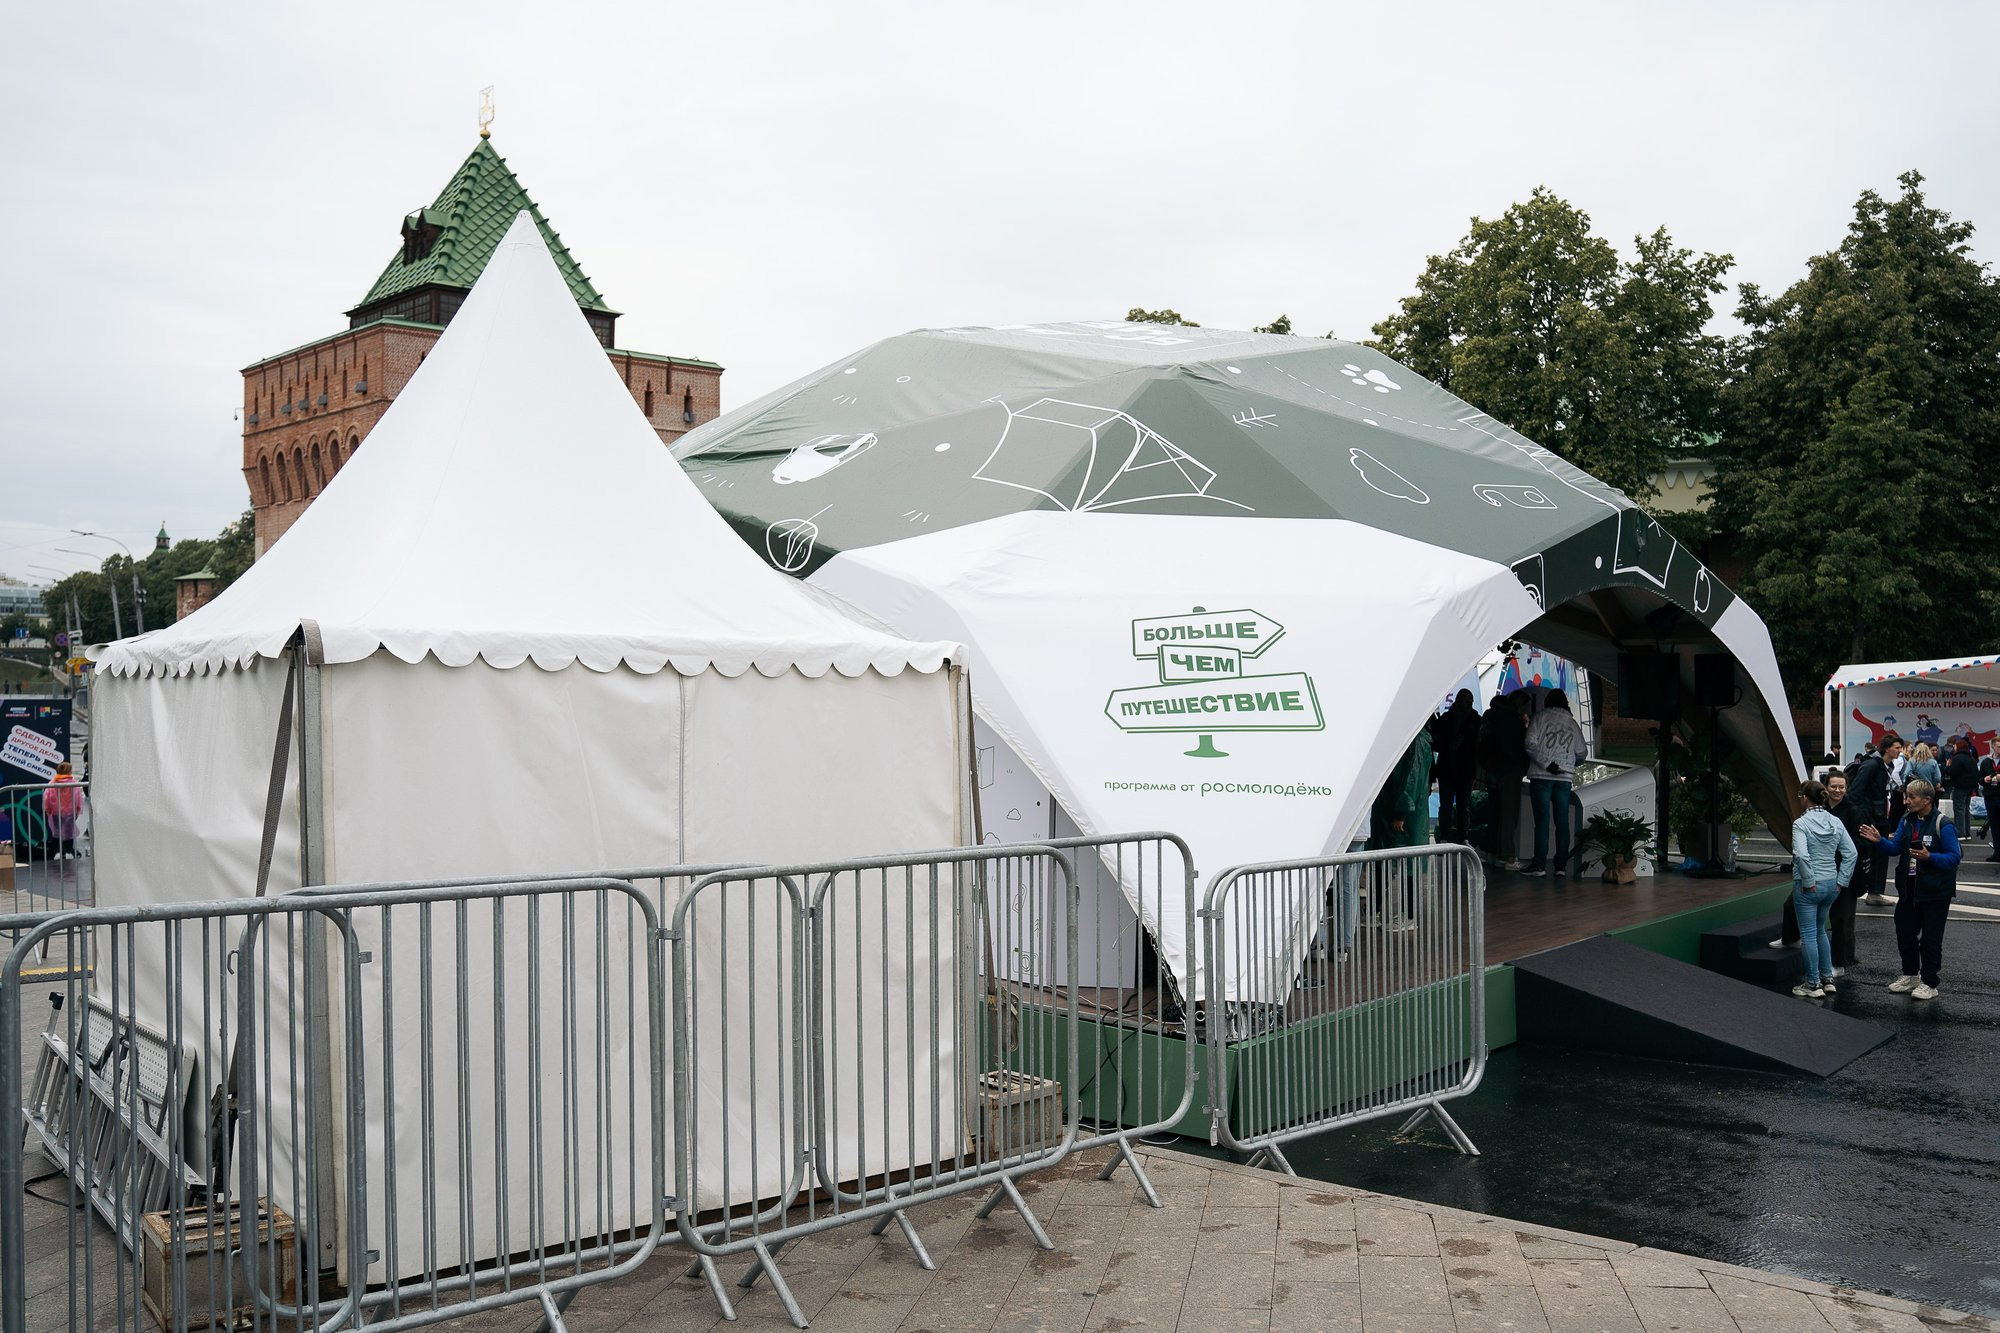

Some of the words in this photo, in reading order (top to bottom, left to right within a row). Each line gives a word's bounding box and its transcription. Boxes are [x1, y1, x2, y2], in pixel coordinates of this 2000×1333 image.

[1143, 621, 1259, 641] БОЛЬШЕ
[1170, 653, 1235, 672] ЧЕМ
[1120, 690, 1304, 716] ПУТЕШЕСТВИЕ
[11, 736, 39, 751] ДРУГОЕ
[15, 728, 52, 748] СДЕЛАЛ
[8, 744, 41, 762] ТЕПЕРЬ
[3, 752, 26, 766] ГУЛЯЙ
[27, 762, 52, 776] СМЕЛО
[1104, 781, 1176, 792] программа
[1181, 783, 1195, 792] от
[1201, 781, 1332, 797] росмолодёжь
